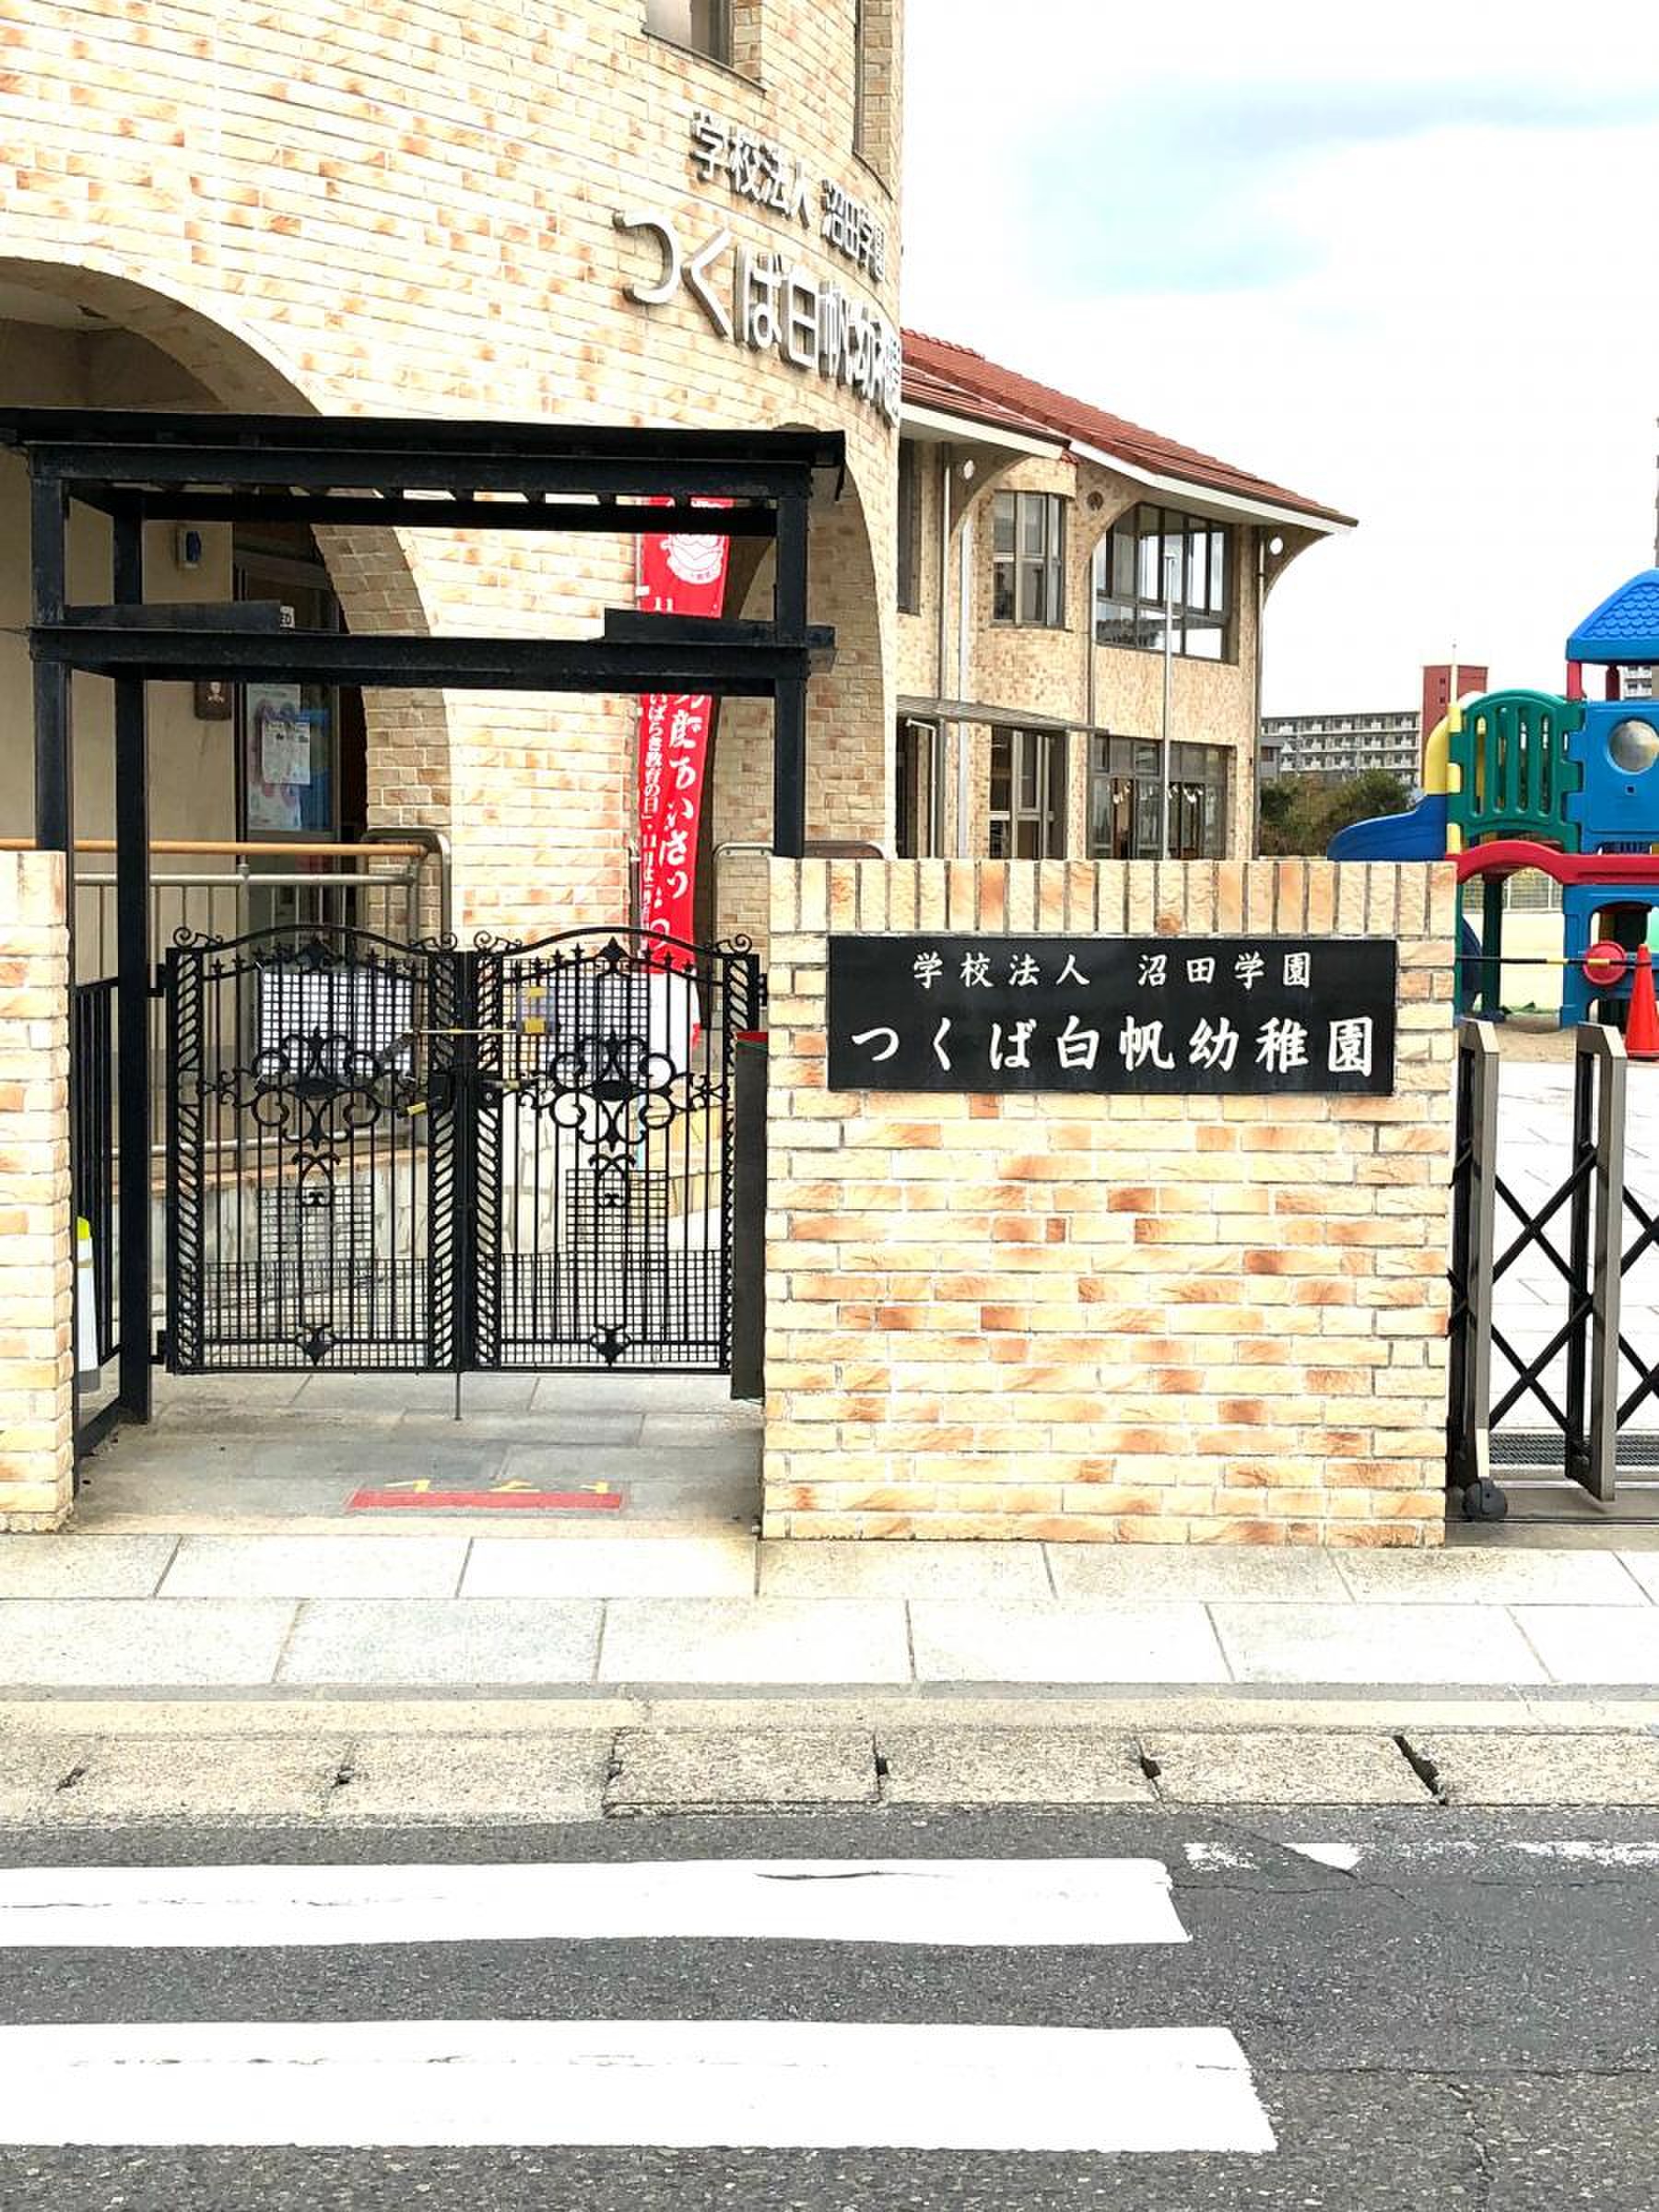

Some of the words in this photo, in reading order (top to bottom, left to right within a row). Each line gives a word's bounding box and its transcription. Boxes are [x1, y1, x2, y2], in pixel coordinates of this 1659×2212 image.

[689, 111, 810, 229] 学校法人
[914, 952, 1089, 988] 学校法人
[1138, 952, 1310, 989] 沼田学園
[852, 1016, 1372, 1077] つくば白帆幼稚園
